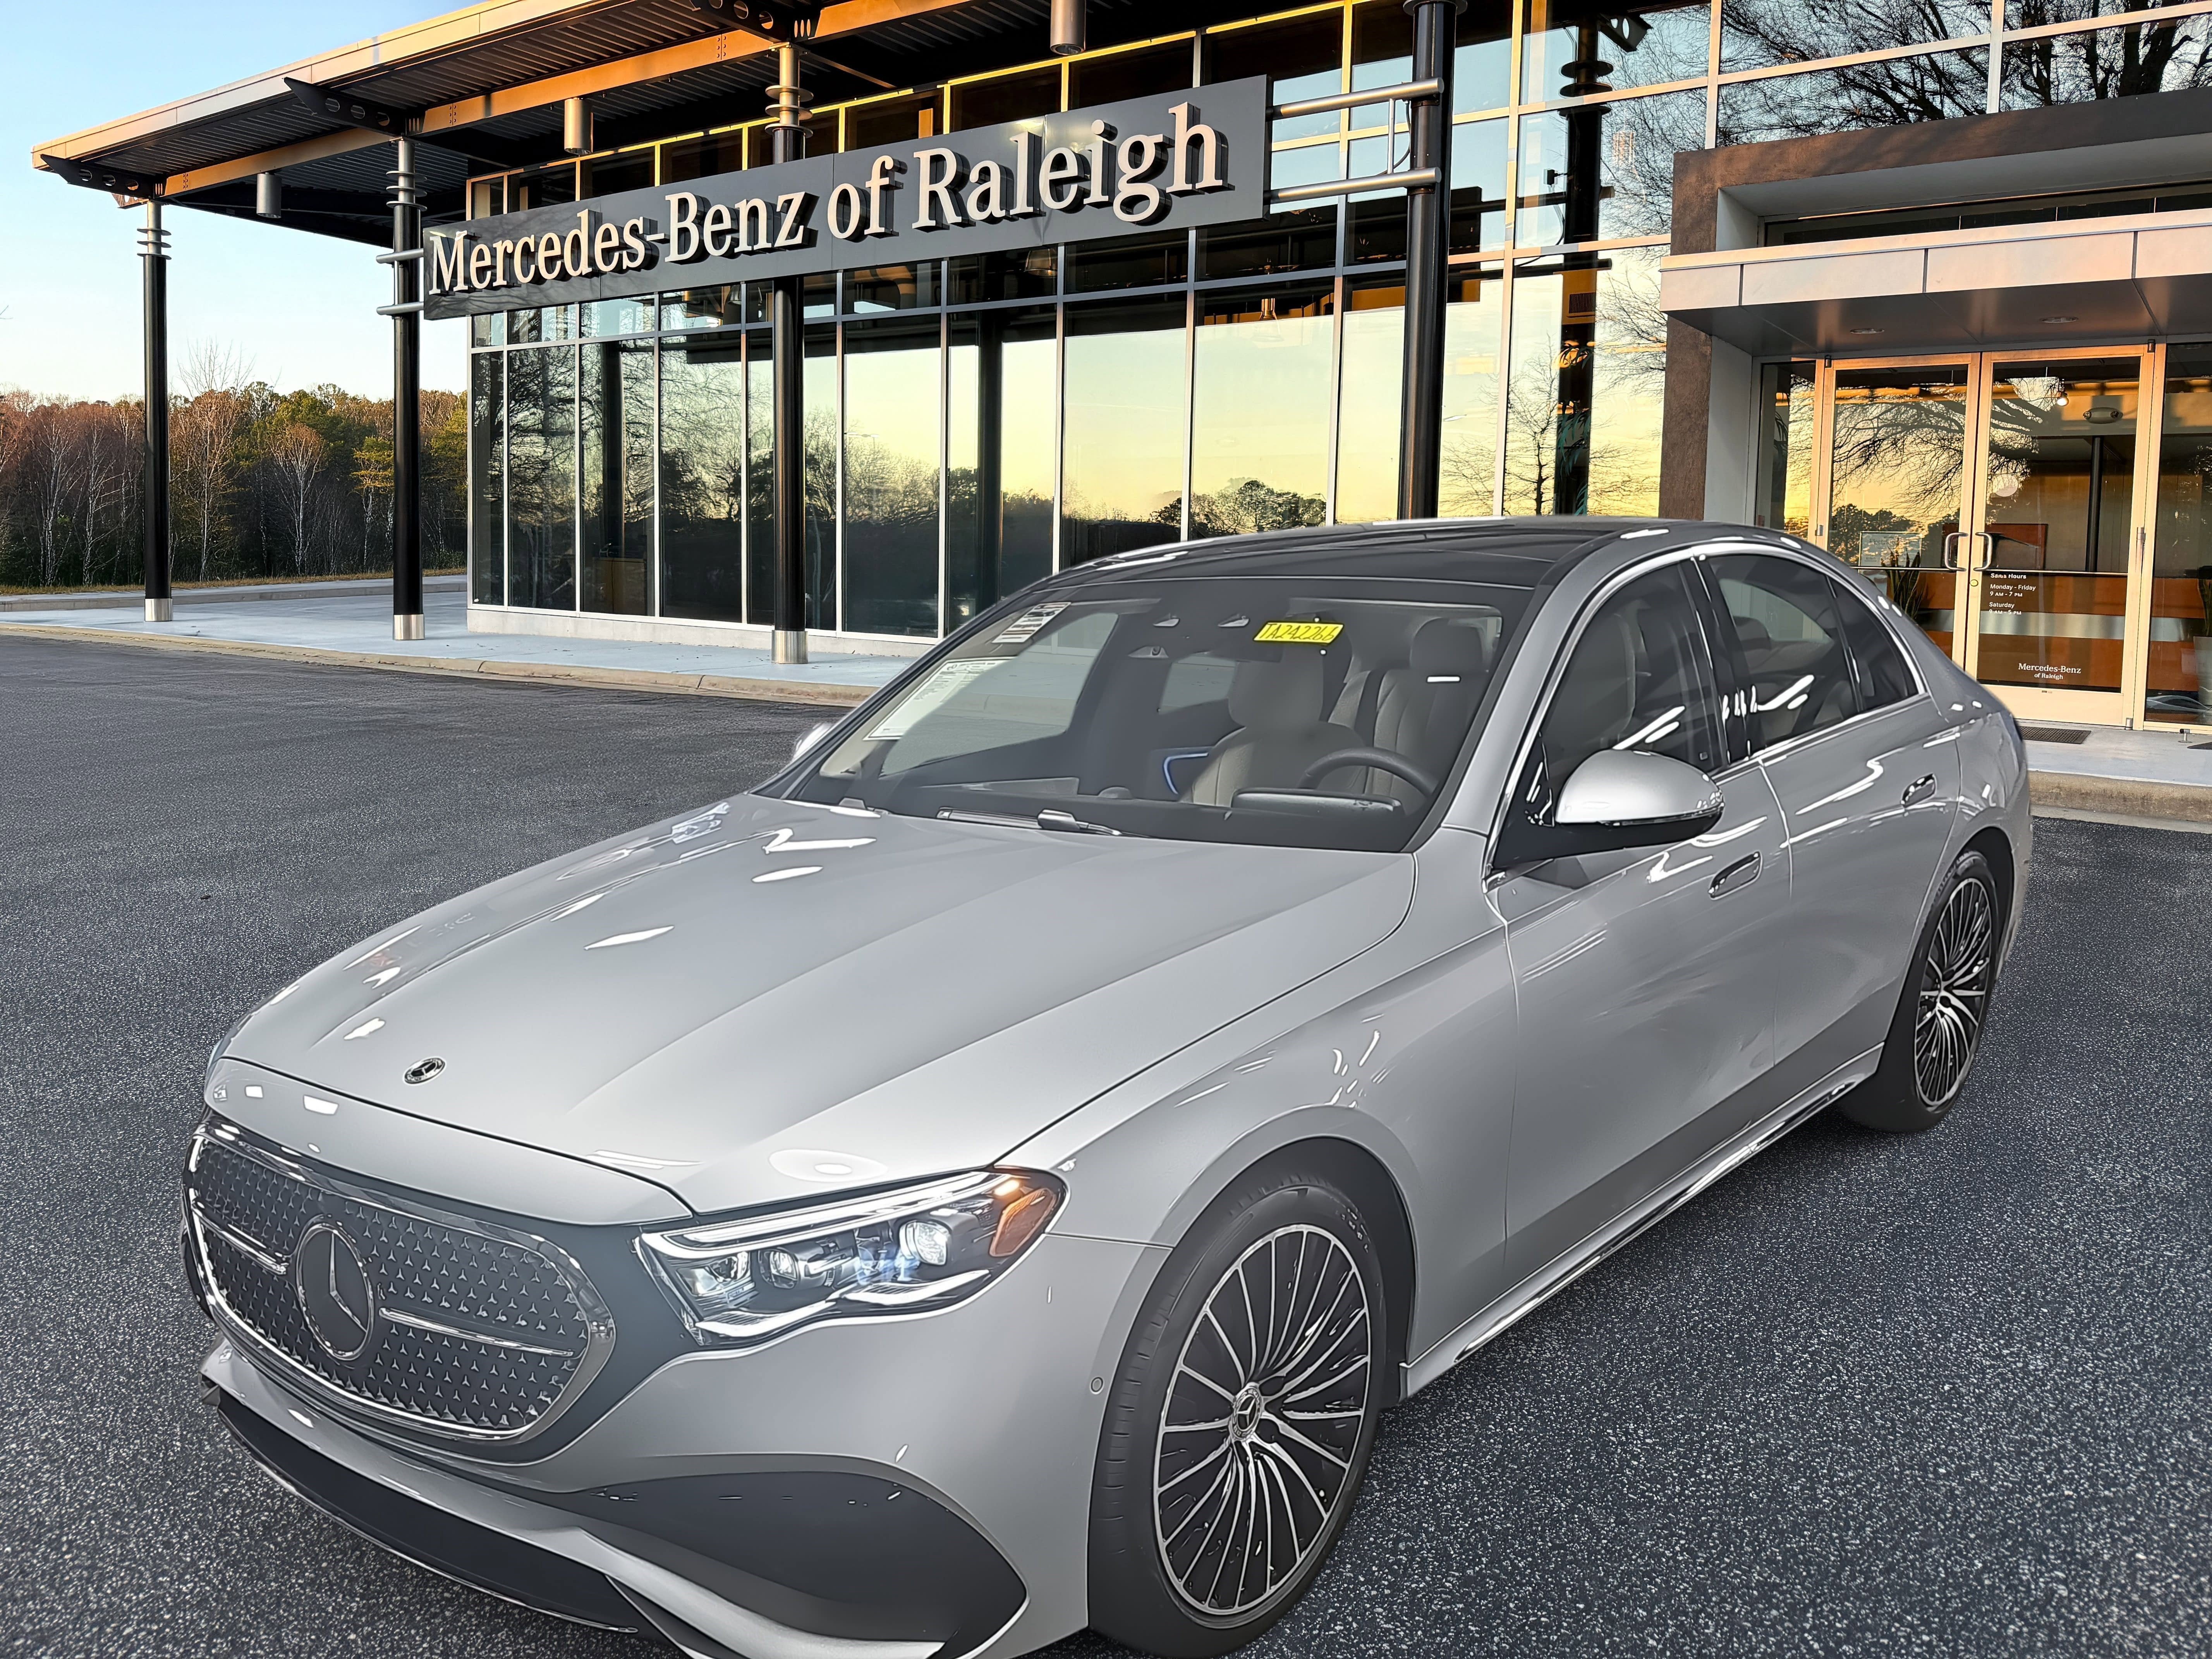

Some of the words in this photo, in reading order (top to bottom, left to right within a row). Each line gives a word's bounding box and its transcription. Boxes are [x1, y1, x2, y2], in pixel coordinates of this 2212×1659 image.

[429, 191, 805, 295] Mercedes-Benz
[827, 155, 894, 239] of
[911, 101, 1223, 222] Raleigh
[2018, 663, 2081, 674] Mercedes-Benz
